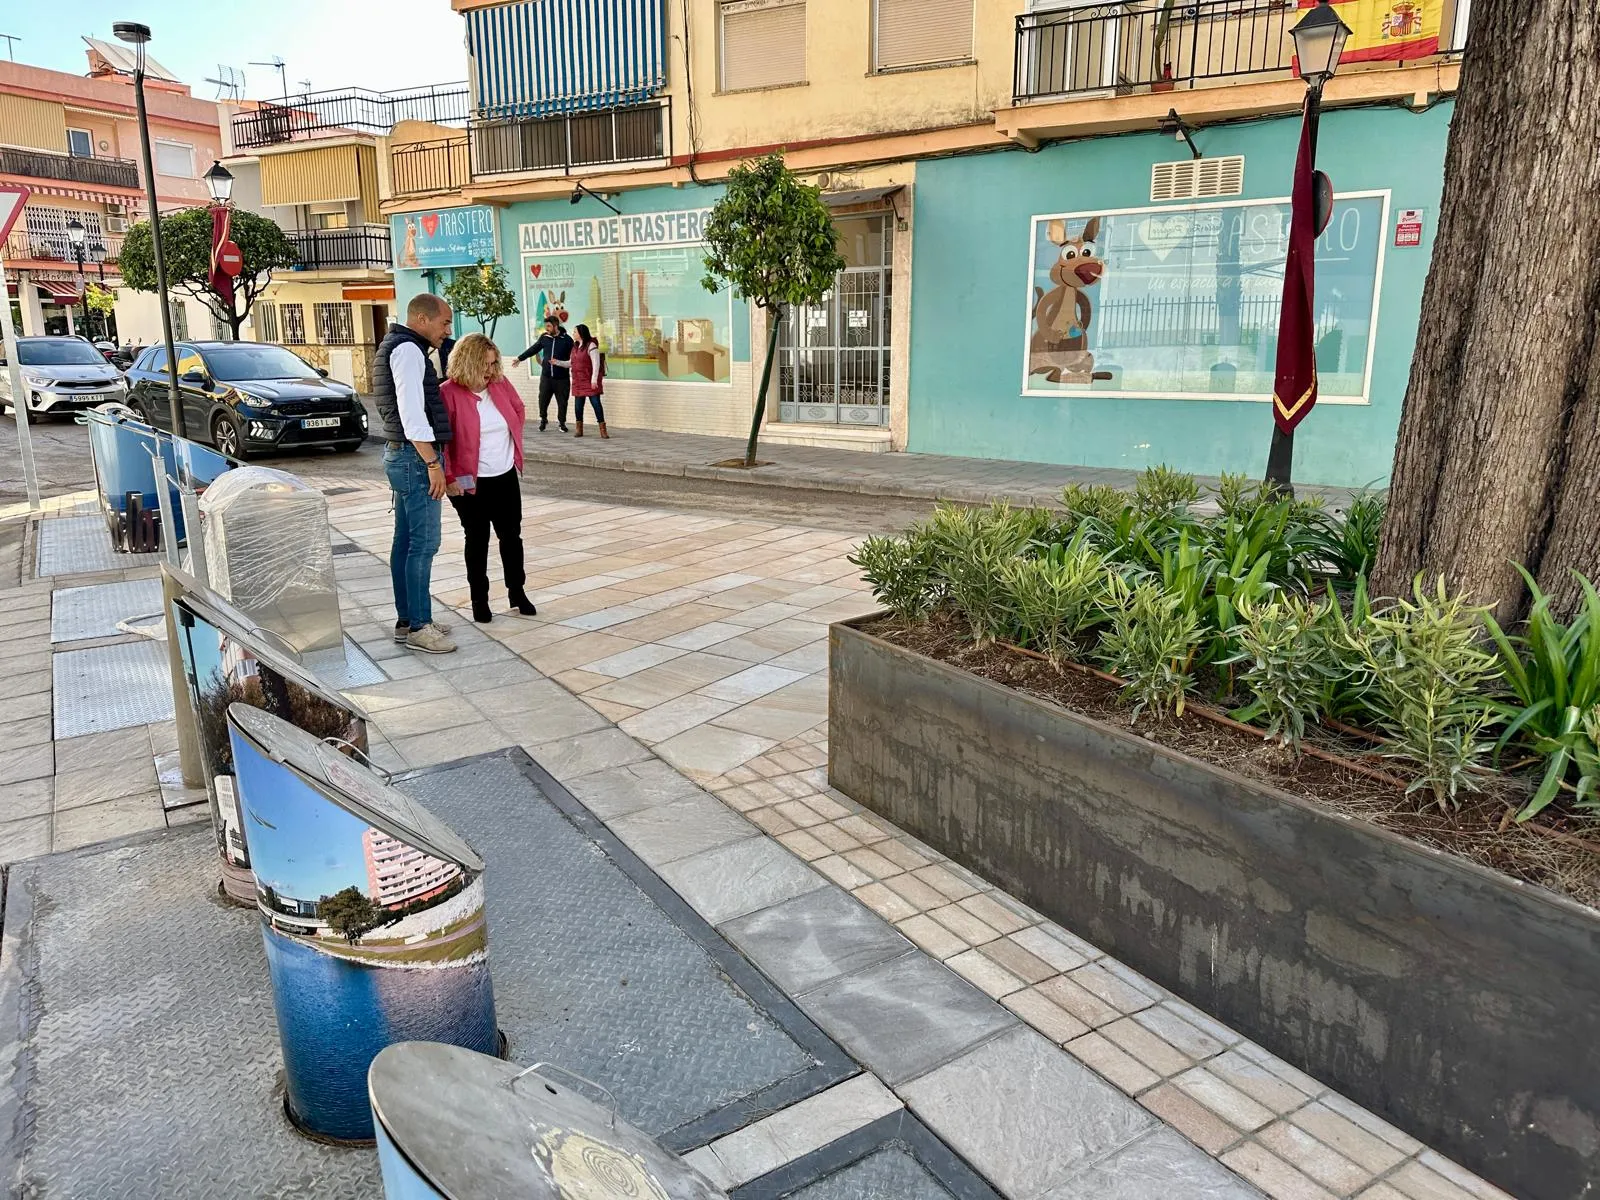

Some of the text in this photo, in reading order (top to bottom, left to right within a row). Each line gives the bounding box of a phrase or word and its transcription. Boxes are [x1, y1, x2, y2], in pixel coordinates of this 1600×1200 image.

[438, 209, 493, 237] TRASTERO
[523, 221, 594, 251] ALQUILER
[598, 218, 619, 245] DE
[1127, 207, 1359, 261] I TRASTRO
[541, 262, 575, 278] TRASTERO
[306, 419, 323, 427] 9361
